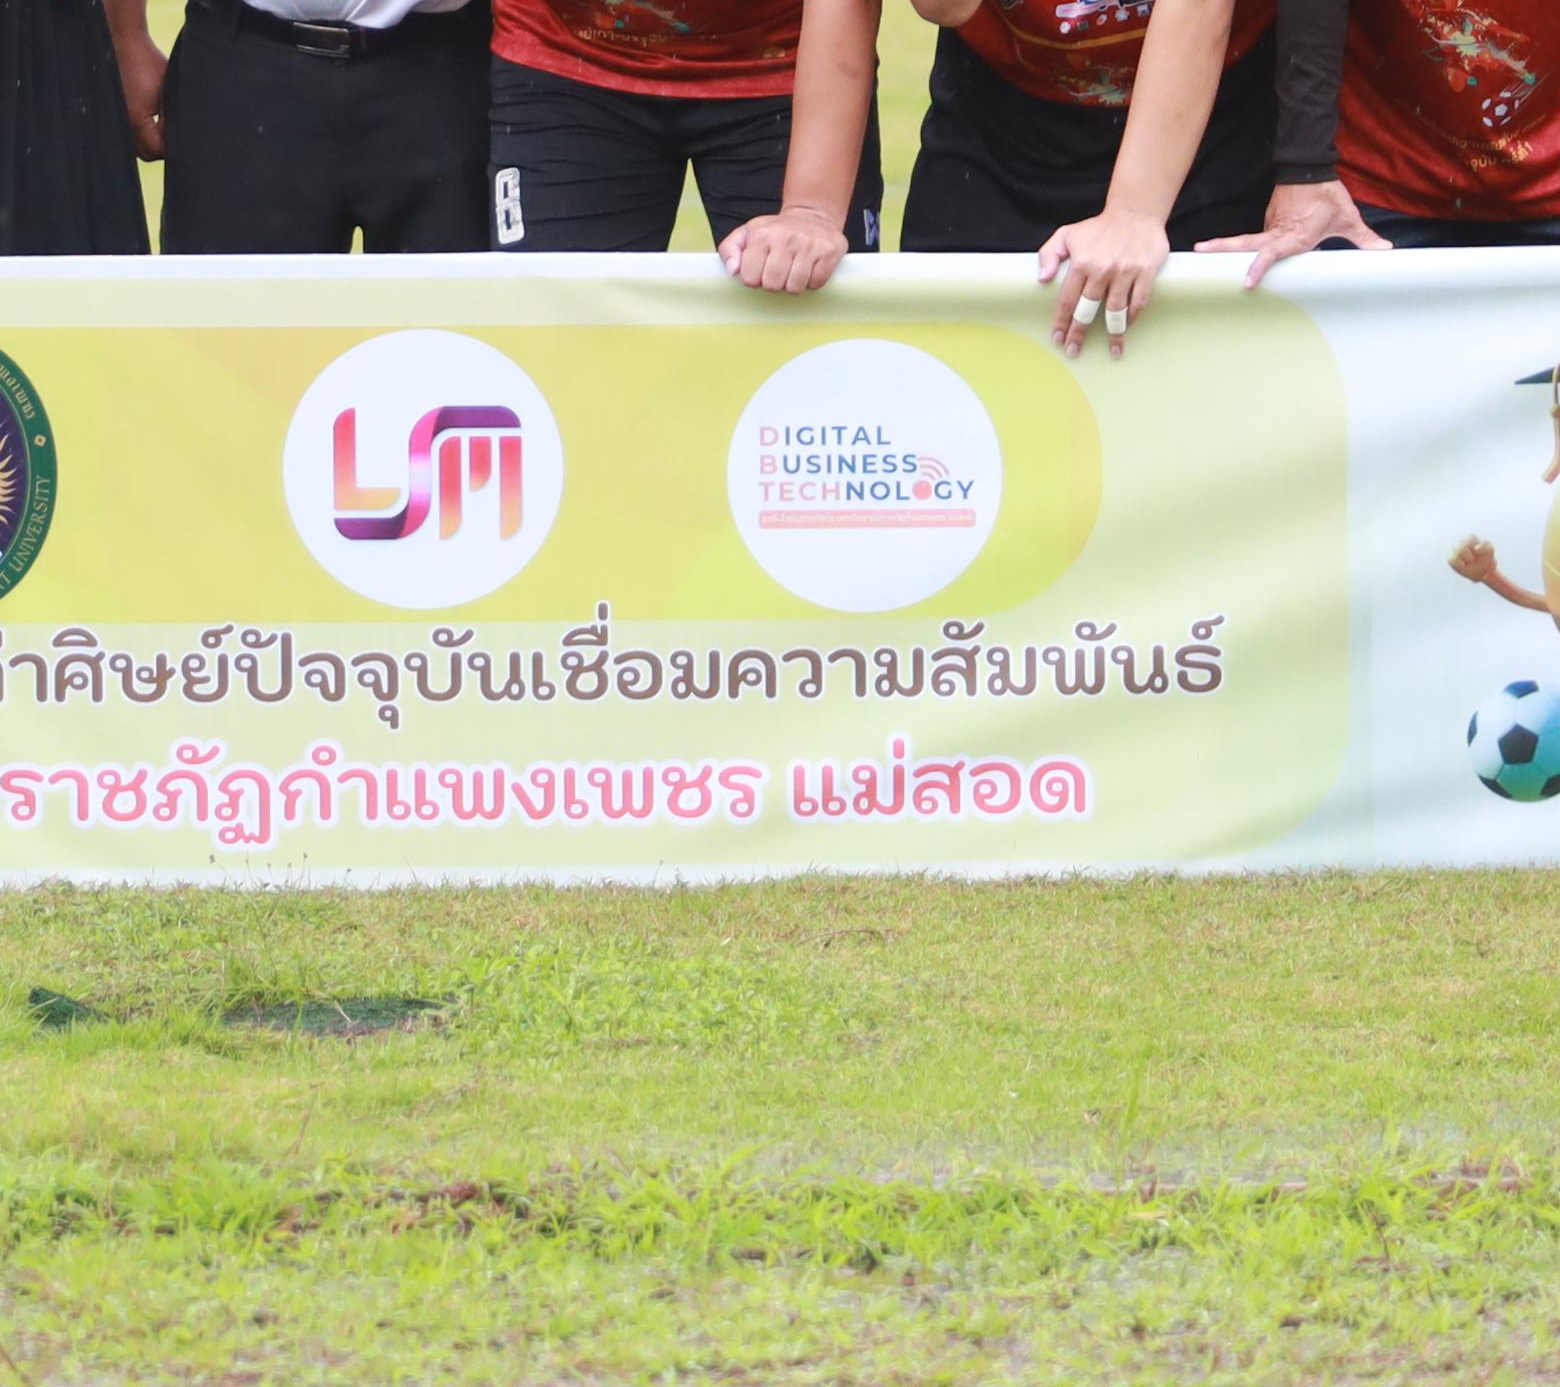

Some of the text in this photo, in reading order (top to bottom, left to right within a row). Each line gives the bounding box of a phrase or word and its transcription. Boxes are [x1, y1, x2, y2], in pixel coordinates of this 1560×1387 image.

[759, 426, 892, 446] DIGITAL
[760, 453, 918, 475] BUSINESS
[758, 480, 975, 502] TECHNOLOGY
[8, 475, 50, 573] UNIVERSITY
[793, 737, 1087, 818] แม่สอด
